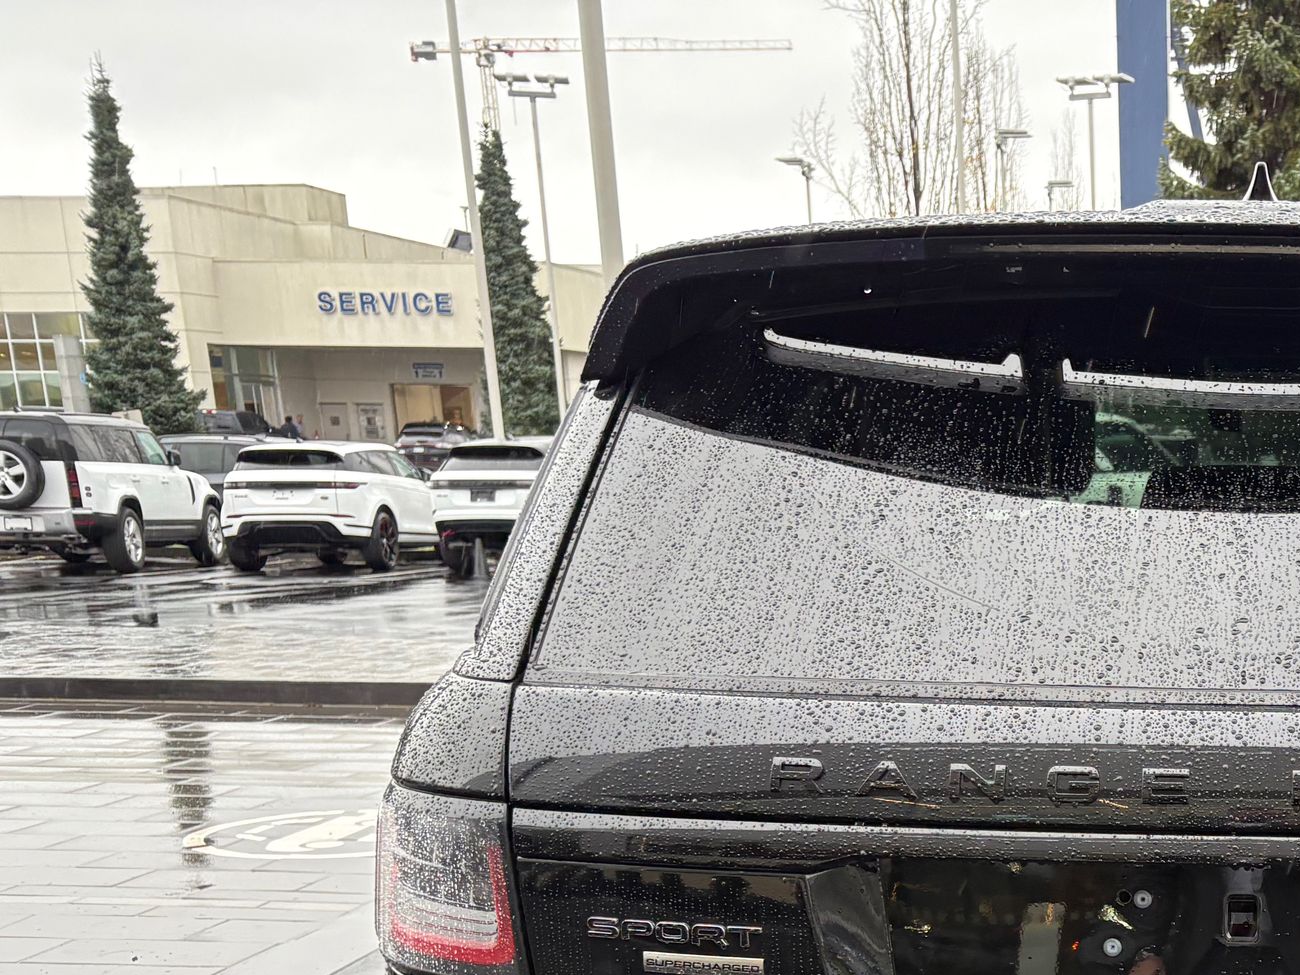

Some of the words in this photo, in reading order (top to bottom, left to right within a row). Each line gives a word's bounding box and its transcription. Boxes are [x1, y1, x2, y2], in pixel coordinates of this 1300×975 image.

[317, 291, 454, 316] SERVICE
[769, 756, 1192, 804] RANGE
[587, 916, 762, 949] SPORT
[646, 958, 760, 973] SUPERCHARGED
